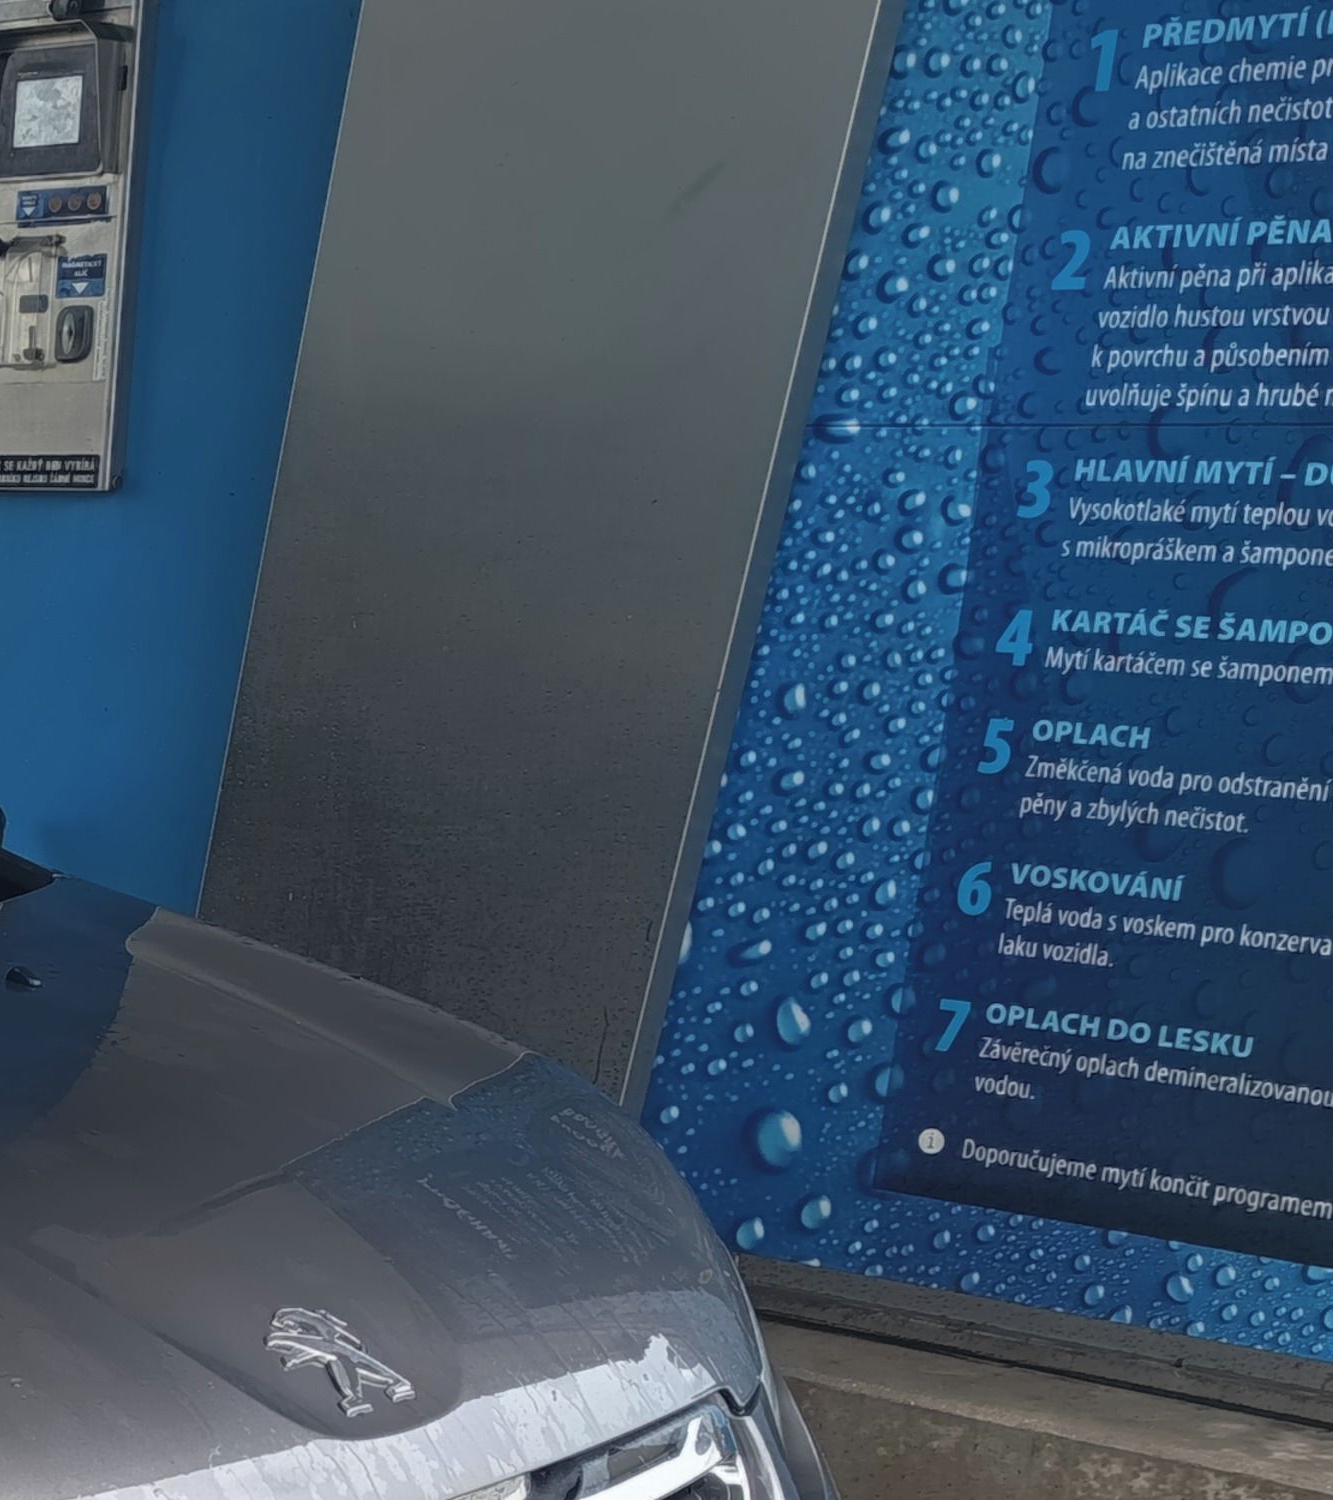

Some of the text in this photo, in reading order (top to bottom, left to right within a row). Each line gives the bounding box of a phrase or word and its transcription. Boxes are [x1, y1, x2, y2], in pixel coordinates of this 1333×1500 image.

[1142, 6, 1312, 49] PŘEDMYTÍ
[1090, 29, 1119, 92] 1
[1135, 63, 1223, 95] Aplikace
[1228, 56, 1307, 81] chemie
[1128, 96, 1333, 130] a ostatních nečistot
[1121, 137, 1328, 171] na znečištěná místa
[1110, 215, 1333, 250] AKTIVNÍ PĚNA
[1051, 229, 1091, 290] 2
[1103, 262, 1179, 290] Aktivní
[1179, 262, 1231, 294] pěna
[1236, 260, 1267, 293] při
[1098, 303, 1329, 328] vozidlo hustou vrstvou
[1091, 341, 1329, 373] k povrchu a působením
[1086, 382, 1319, 412] uvolňuje špínu a hrubé
[1017, 459, 1054, 518] 3
[1074, 455, 1191, 483] HLAVNÍ
[1194, 456, 1277, 485] MYTÍ
[1069, 497, 1185, 525] Vysokotlaké
[1190, 499, 1241, 529] mytí
[1243, 502, 1311, 530] teplou
[1060, 535, 1333, 571] s mikropráškem a šampone
[996, 609, 1033, 666] 4
[1051, 608, 1333, 645] KARTÁČ SE ŠAMPO
[1045, 646, 1333, 687] Mytí kartáčem se šamponem
[977, 718, 1014, 774] 5
[1032, 719, 1151, 749] OPLACH
[1024, 755, 1333, 803] Změkčená voda pro odstranění
[1019, 794, 1249, 833] pěny a zbylých nečistot.
[956, 861, 993, 916] 6
[1010, 862, 1186, 902] VOSKOVÁNÍ
[1005, 898, 1333, 956] Teplá voda s voskem pro konzerva
[998, 933, 1115, 967] laku vozidla.
[934, 998, 972, 1052] 7
[986, 1003, 1254, 1059] OPLACH DO LESKU
[974, 1074, 1035, 1100] vodou.
[978, 1035, 1333, 1108] Závěrečný oplach demineralizovanou
[962, 1138, 1097, 1181] Doporučujeme
[1101, 1165, 1146, 1191] mytí
[1149, 1169, 1211, 1199] končit
[1214, 1183, 1333, 1221] programem
